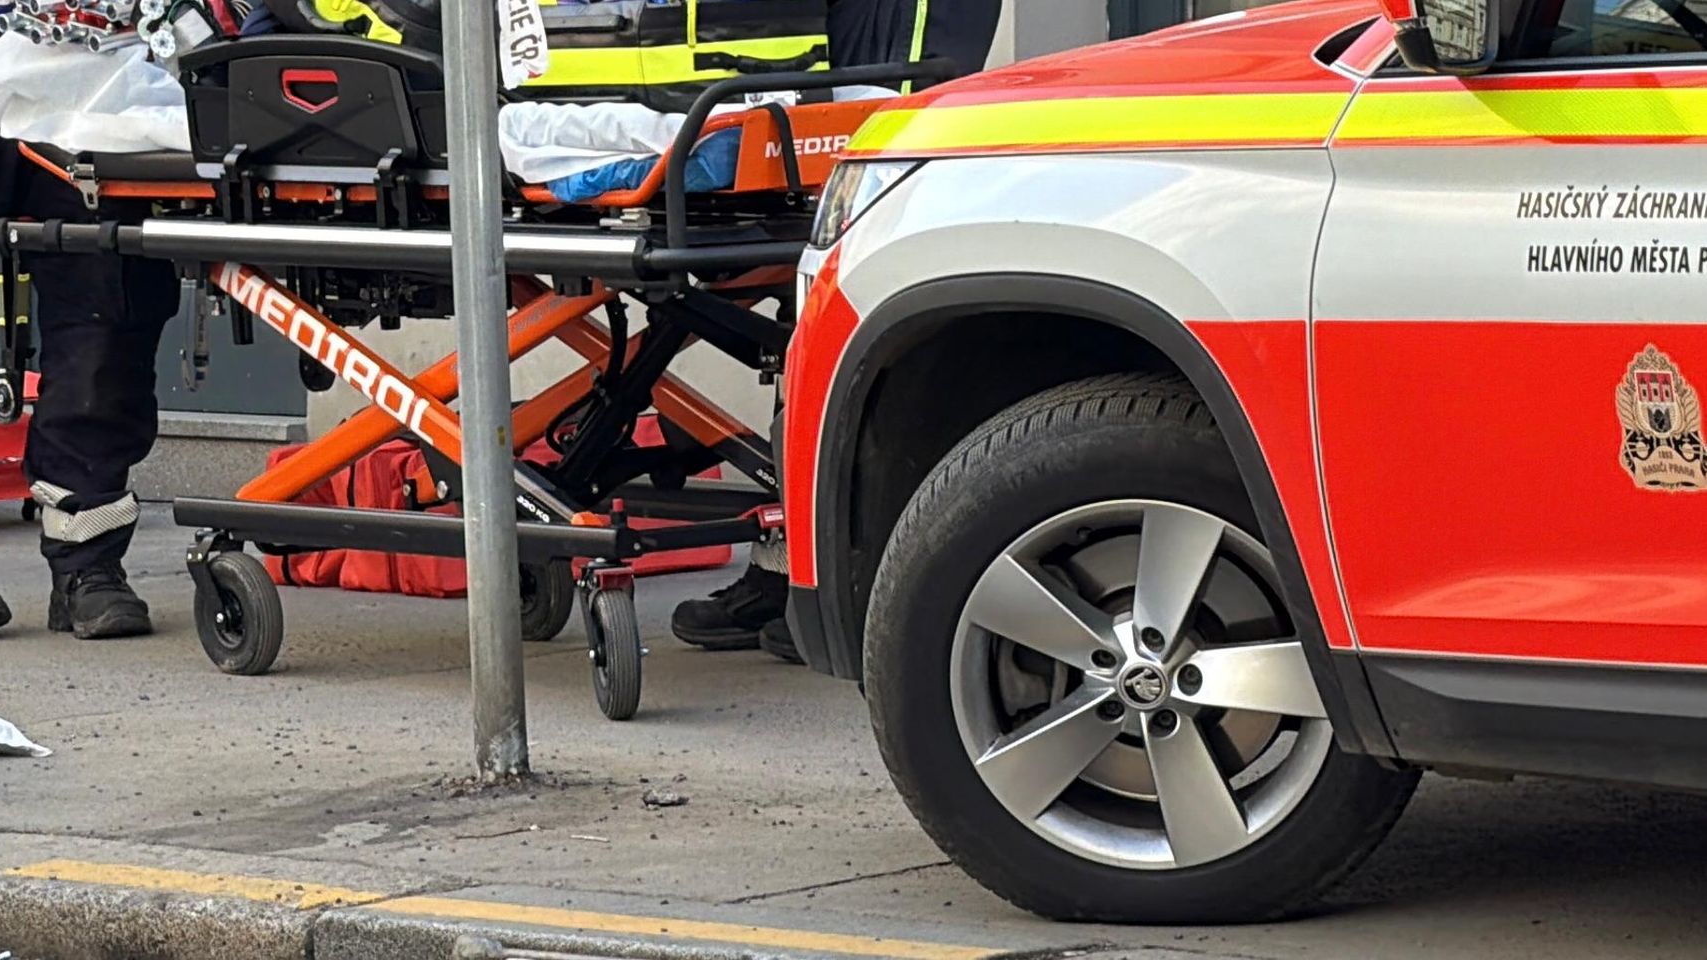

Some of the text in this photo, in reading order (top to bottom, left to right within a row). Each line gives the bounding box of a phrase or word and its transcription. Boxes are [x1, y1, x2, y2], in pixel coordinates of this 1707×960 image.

[1517, 185, 1707, 219] HASIČSKÝ ZÁCHRAN
[1527, 239, 1623, 273] HLAVNÍHO
[1630, 239, 1690, 273] MĚSTA
